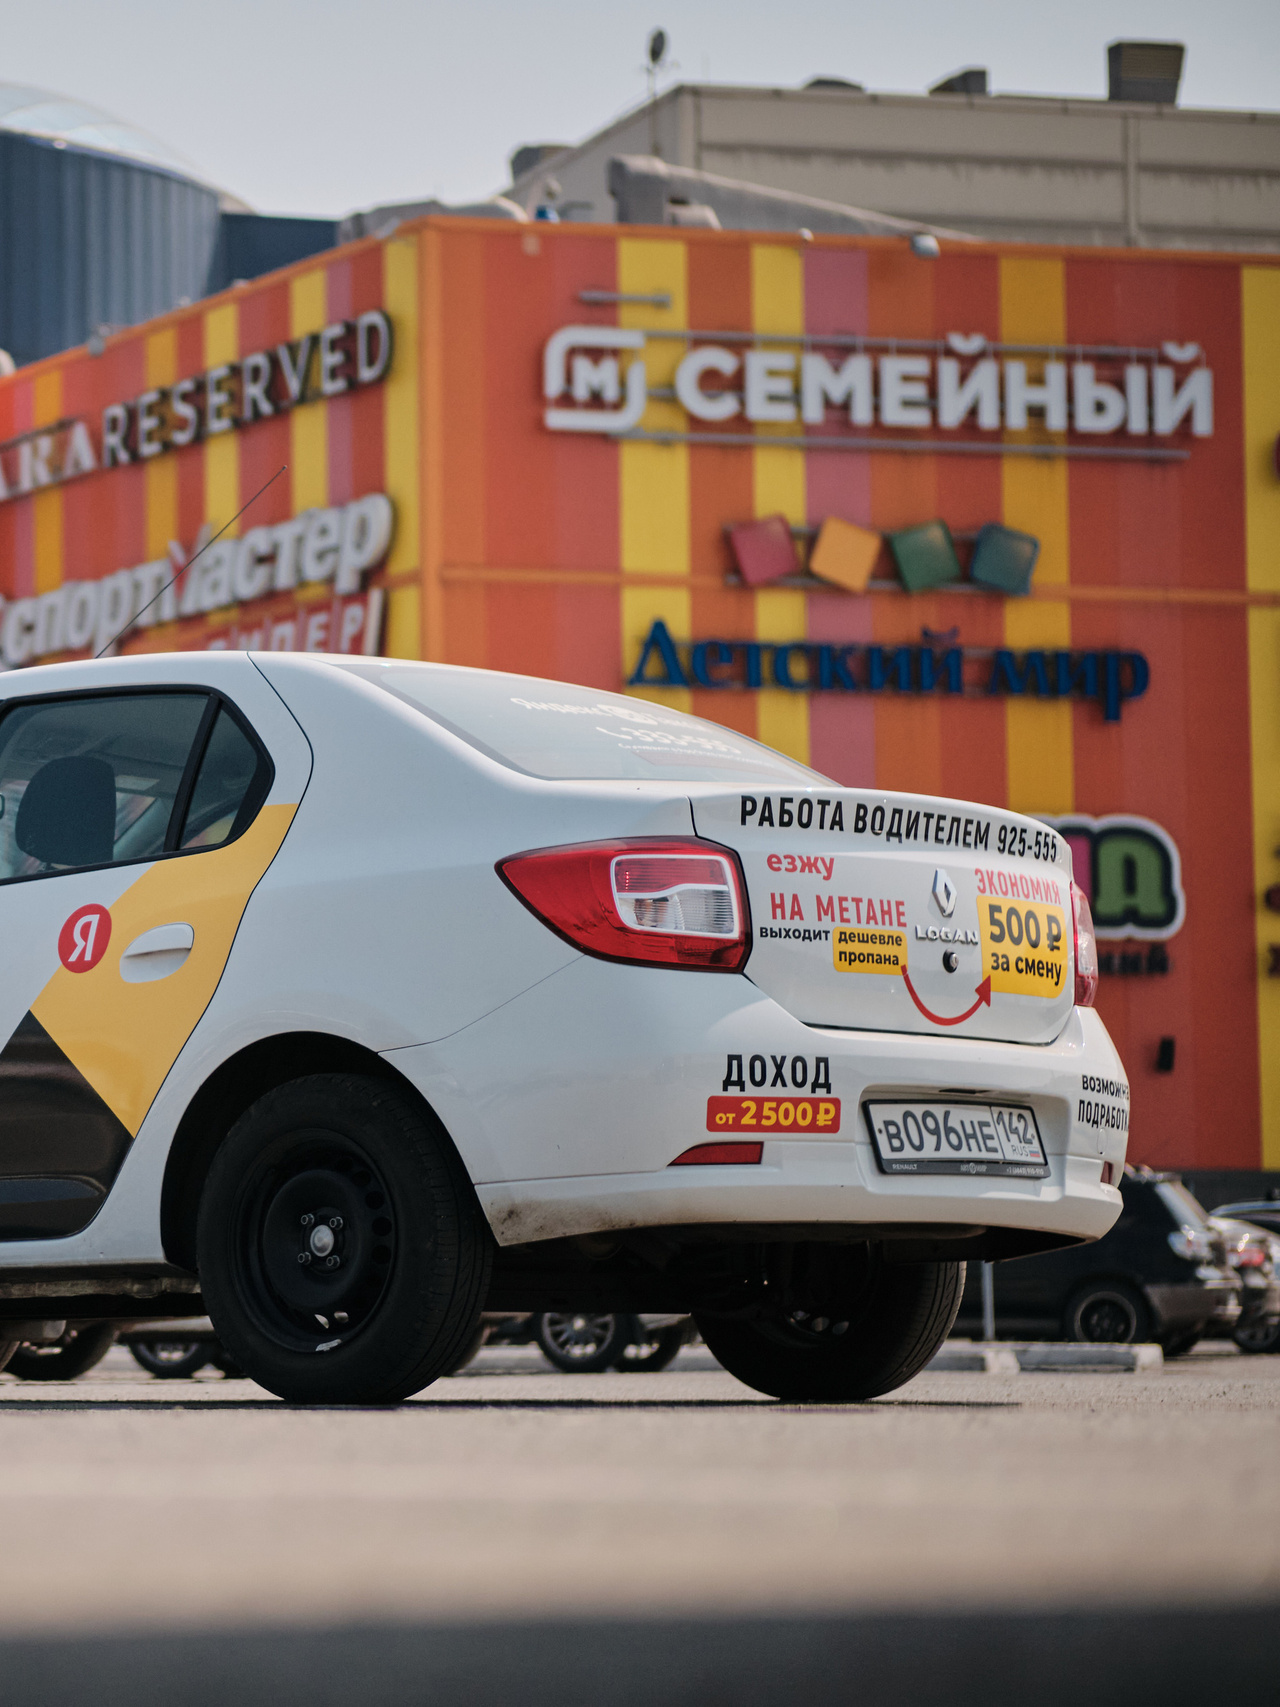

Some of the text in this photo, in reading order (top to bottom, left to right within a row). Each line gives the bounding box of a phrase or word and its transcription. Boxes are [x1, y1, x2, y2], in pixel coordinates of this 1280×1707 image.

[101, 308, 396, 472] RESERVED
[675, 332, 1214, 437] СЕМЕЙНЫЙ
[628, 618, 1151, 723] Детский мир
[740, 795, 1058, 863] РАБОТА ВОДИТЕЛЕМ 925-555
[766, 853, 835, 881] езжу
[974, 868, 1062, 905] ЭКОНОМИЯ
[770, 892, 908, 928] НА МЕТАНЕ
[988, 904, 1041, 949] 500
[67, 914, 110, 962] Я
[759, 926, 903, 947] выходит дешевле
[915, 925, 979, 946] LOGAN
[838, 950, 900, 966] пропана
[991, 952, 1062, 987] за смену
[722, 1054, 832, 1095] ДОХОД
[715, 1112, 736, 1125] от
[996, 1110, 1034, 1145] 142
[1011, 1144, 1029, 1157] RUS
